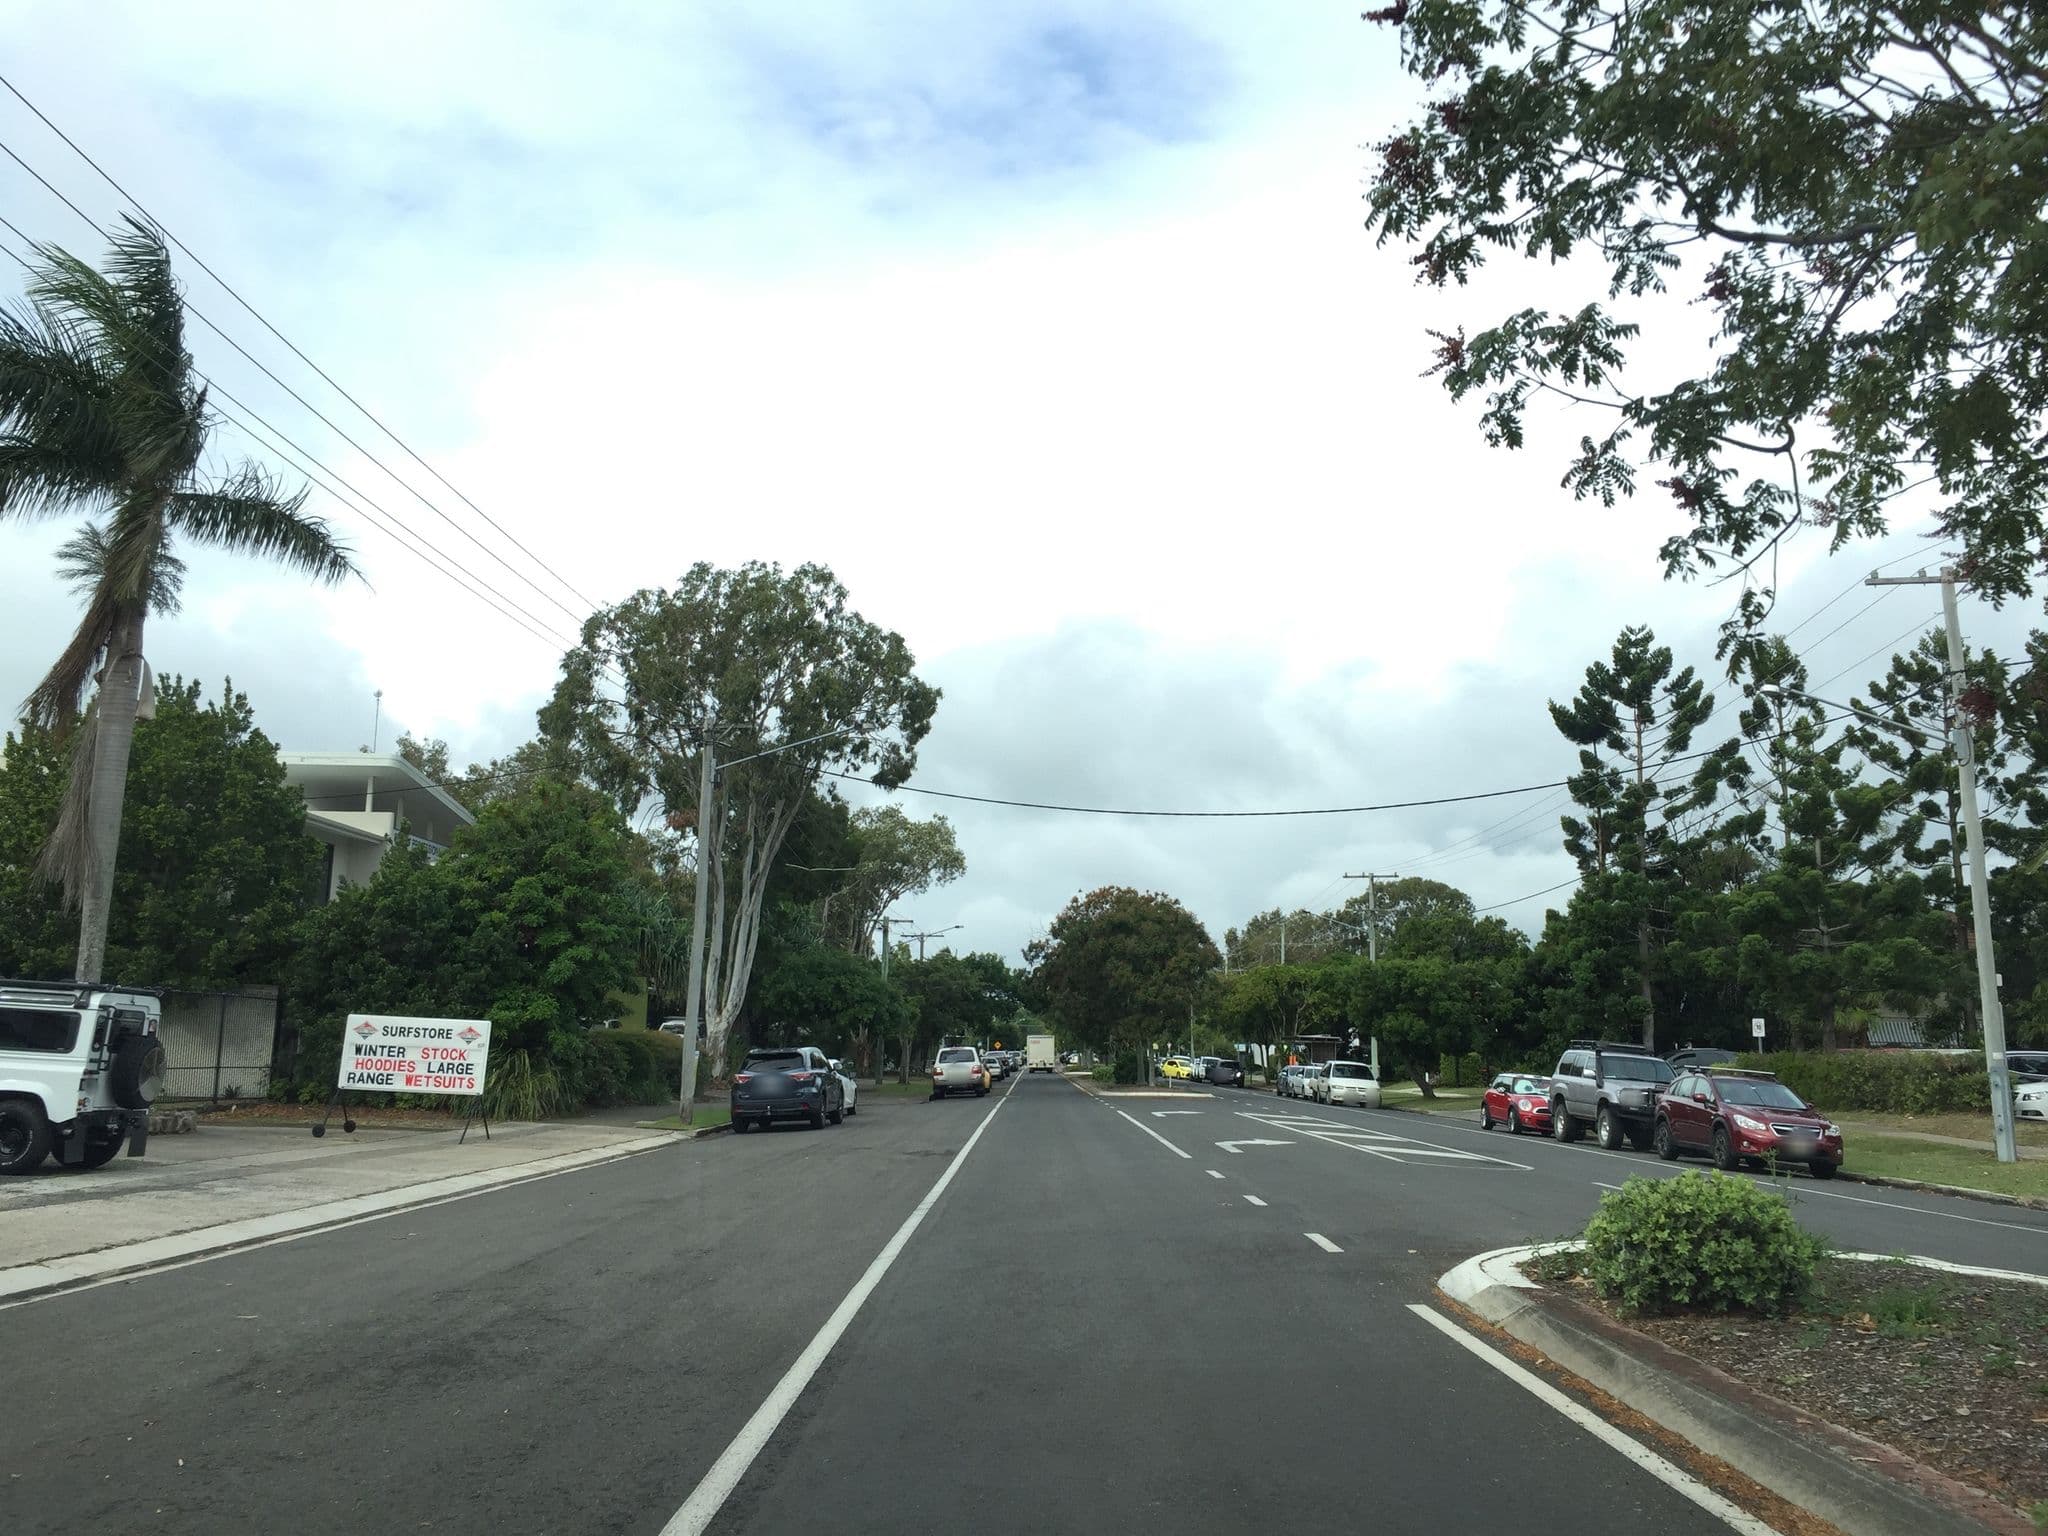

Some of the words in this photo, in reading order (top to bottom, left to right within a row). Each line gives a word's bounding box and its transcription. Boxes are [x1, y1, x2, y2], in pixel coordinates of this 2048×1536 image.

[382, 1026, 453, 1039] SURFSTORE
[354, 1044, 406, 1058] WINTER
[421, 1047, 468, 1061] STOCK
[355, 1058, 416, 1072] HOODIES
[427, 1062, 474, 1075] LARGE
[347, 1072, 394, 1086] RANGE
[405, 1075, 475, 1089] WETSUITS
